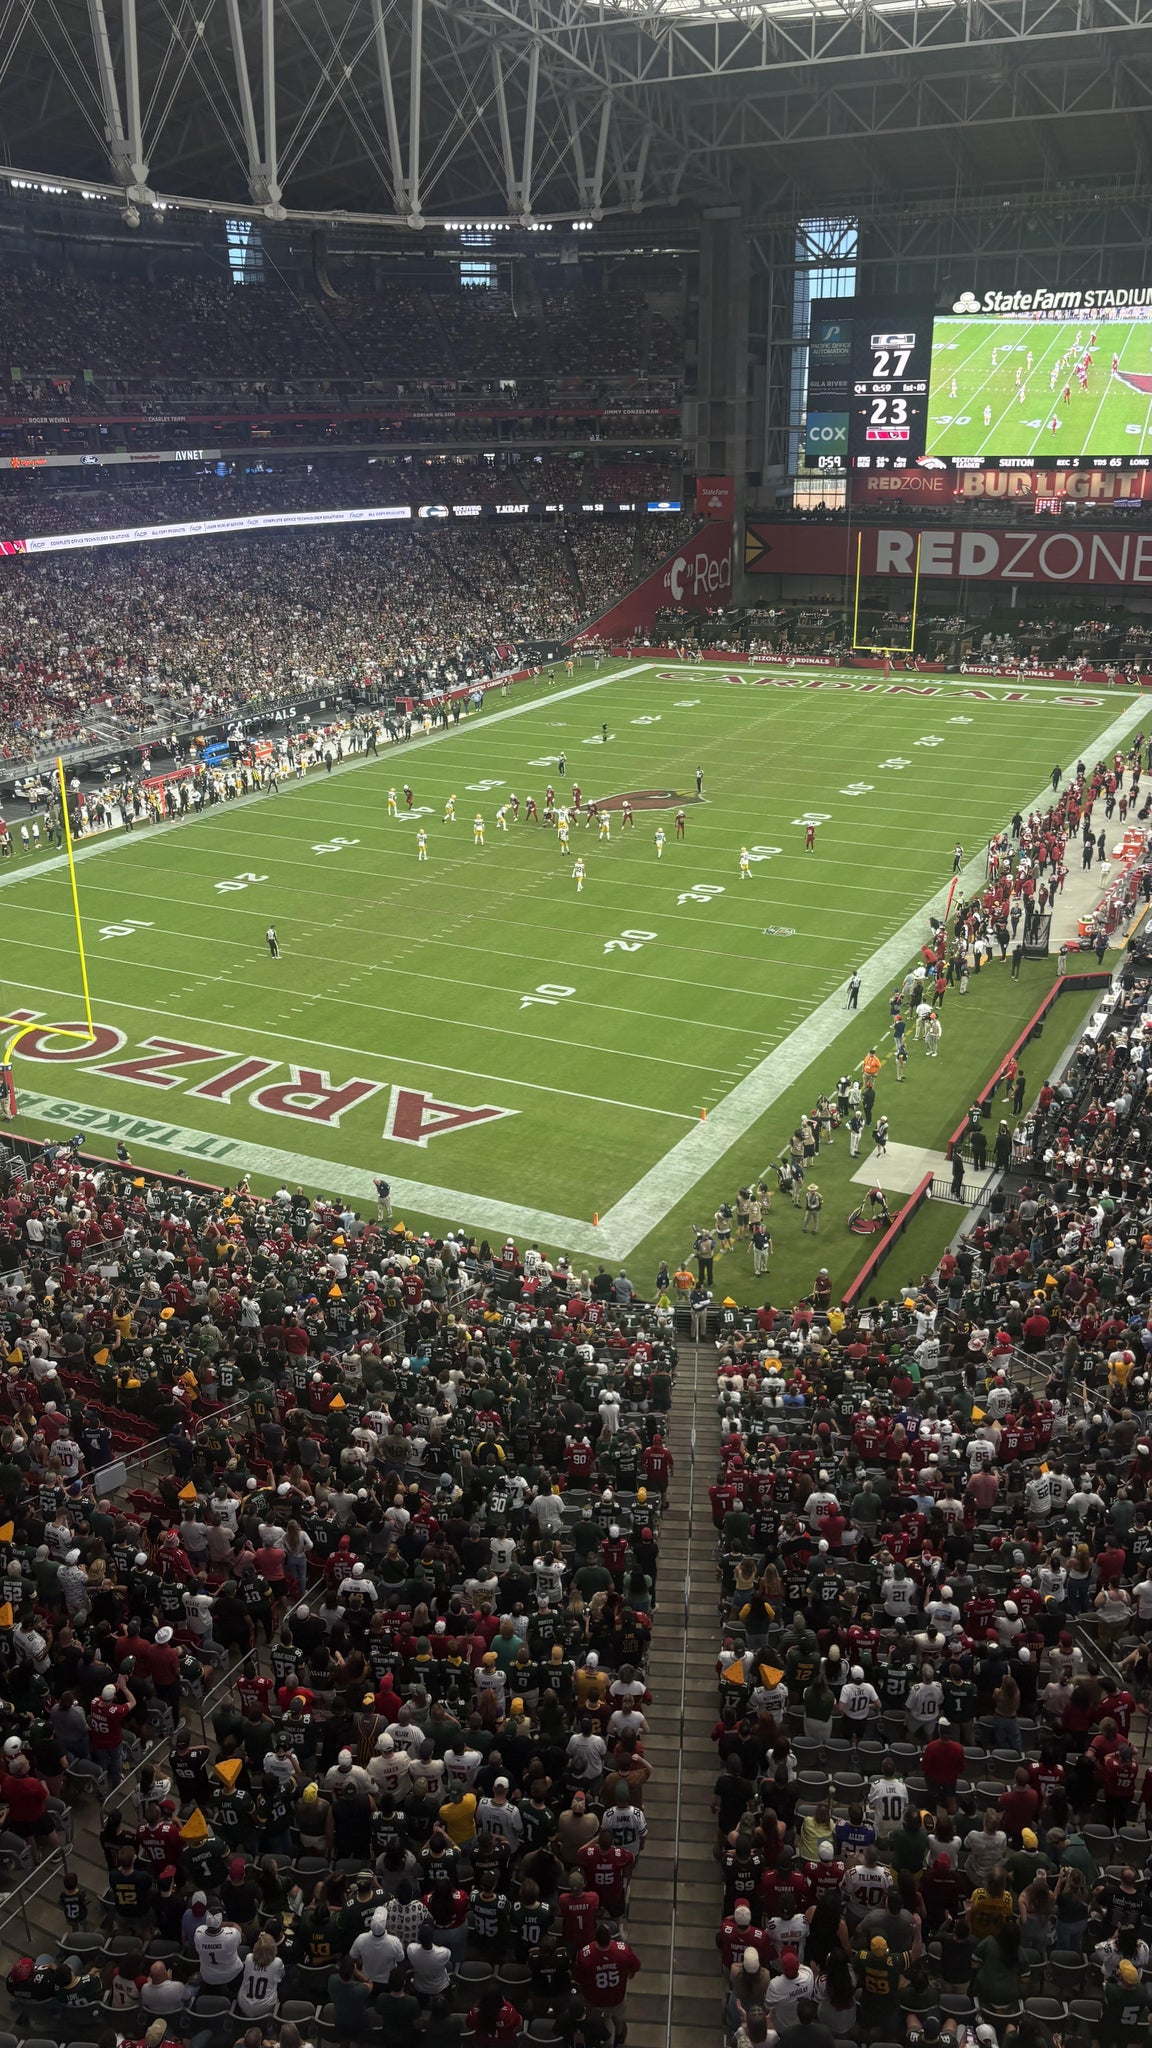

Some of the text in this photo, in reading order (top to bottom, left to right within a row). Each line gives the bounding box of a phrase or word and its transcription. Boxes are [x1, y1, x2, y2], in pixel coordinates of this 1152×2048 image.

[873, 351, 911, 377] 27
[854, 385, 867, 393] Q4
[872, 384, 891, 392] 0:59
[870, 399, 908, 424] 23
[810, 427, 846, 440] COX
[818, 456, 841, 468] 0:59
[1000, 459, 1034, 467] SUTTON
[1072, 459, 1079, 467] 5
[1110, 458, 1122, 466] 65
[868, 476, 943, 490] REDZONE
[963, 472, 1138, 498] BUD LIGHT
[876, 530, 1152, 582] REDZONE
[655, 672, 1106, 707] CARDINALS
[214, 872, 269, 891] 20
[678, 884, 725, 903] 30
[98, 919, 155, 937] 10
[604, 930, 658, 952] 20
[520, 984, 576, 1006] 10
[41, 1103, 241, 1159] IT TAKES
[133, 1268, 144, 1277] 12
[724, 1314, 734, 1323] 10
[1084, 1360, 1093, 1371] 10
[220, 1373, 233, 1386] 12
[295, 1376, 306, 1388] 12
[841, 1405, 854, 1414] 80
[907, 1422, 916, 1432] 18
[866, 1439, 873, 1449] 11
[1008, 1438, 1018, 1448] 18
[573, 1455, 587, 1464] 90
[976, 1452, 989, 1462] 85
[653, 1459, 661, 1469] 11
[1050, 1483, 1061, 1496] 12
[491, 1499, 506, 1512] 30
[635, 1516, 649, 1525] 23
[761, 1524, 774, 1532] 22
[315, 1531, 328, 1543] 10
[498, 1552, 506, 1562] 5
[3, 1589, 22, 1601] 52
[245, 1591, 261, 1602] 10
[821, 1587, 839, 1599] 87
[892, 1591, 906, 1602] 21
[186, 1607, 198, 1618] 10
[1022, 1605, 1030, 1614] 3
[980, 1616, 987, 1626] 11
[539, 1626, 553, 1639] 12
[887, 1679, 906, 1695] 21
[766, 1702, 781, 1711] 23
[850, 1697, 868, 1712] 10
[921, 1701, 936, 1715] 10
[955, 1699, 961, 1711] 1
[176, 1769, 195, 1779] 99
[386, 1775, 399, 1791] 3
[272, 1804, 286, 1821] 10
[883, 1796, 901, 1821] 10
[220, 1810, 238, 1826] 10
[616, 1815, 631, 1823] HAWK
[849, 1834, 865, 1842] ALLEN
[151, 1848, 166, 1861] 18
[201, 1861, 212, 1876] 1
[595, 1873, 615, 1885] 85
[858, 1873, 882, 1883] TILLMAN
[734, 1881, 755, 1891] 99
[116, 1891, 137, 1905] 12
[855, 1887, 885, 1906] 40
[66, 1904, 80, 1918] 12
[577, 1916, 584, 1930] 1
[521, 1925, 541, 1944] 10
[208, 1952, 218, 1965] 1
[595, 1970, 620, 1989] 85
[247, 1977, 269, 2000] 10
[789, 1986, 809, 1997] MURRAY
